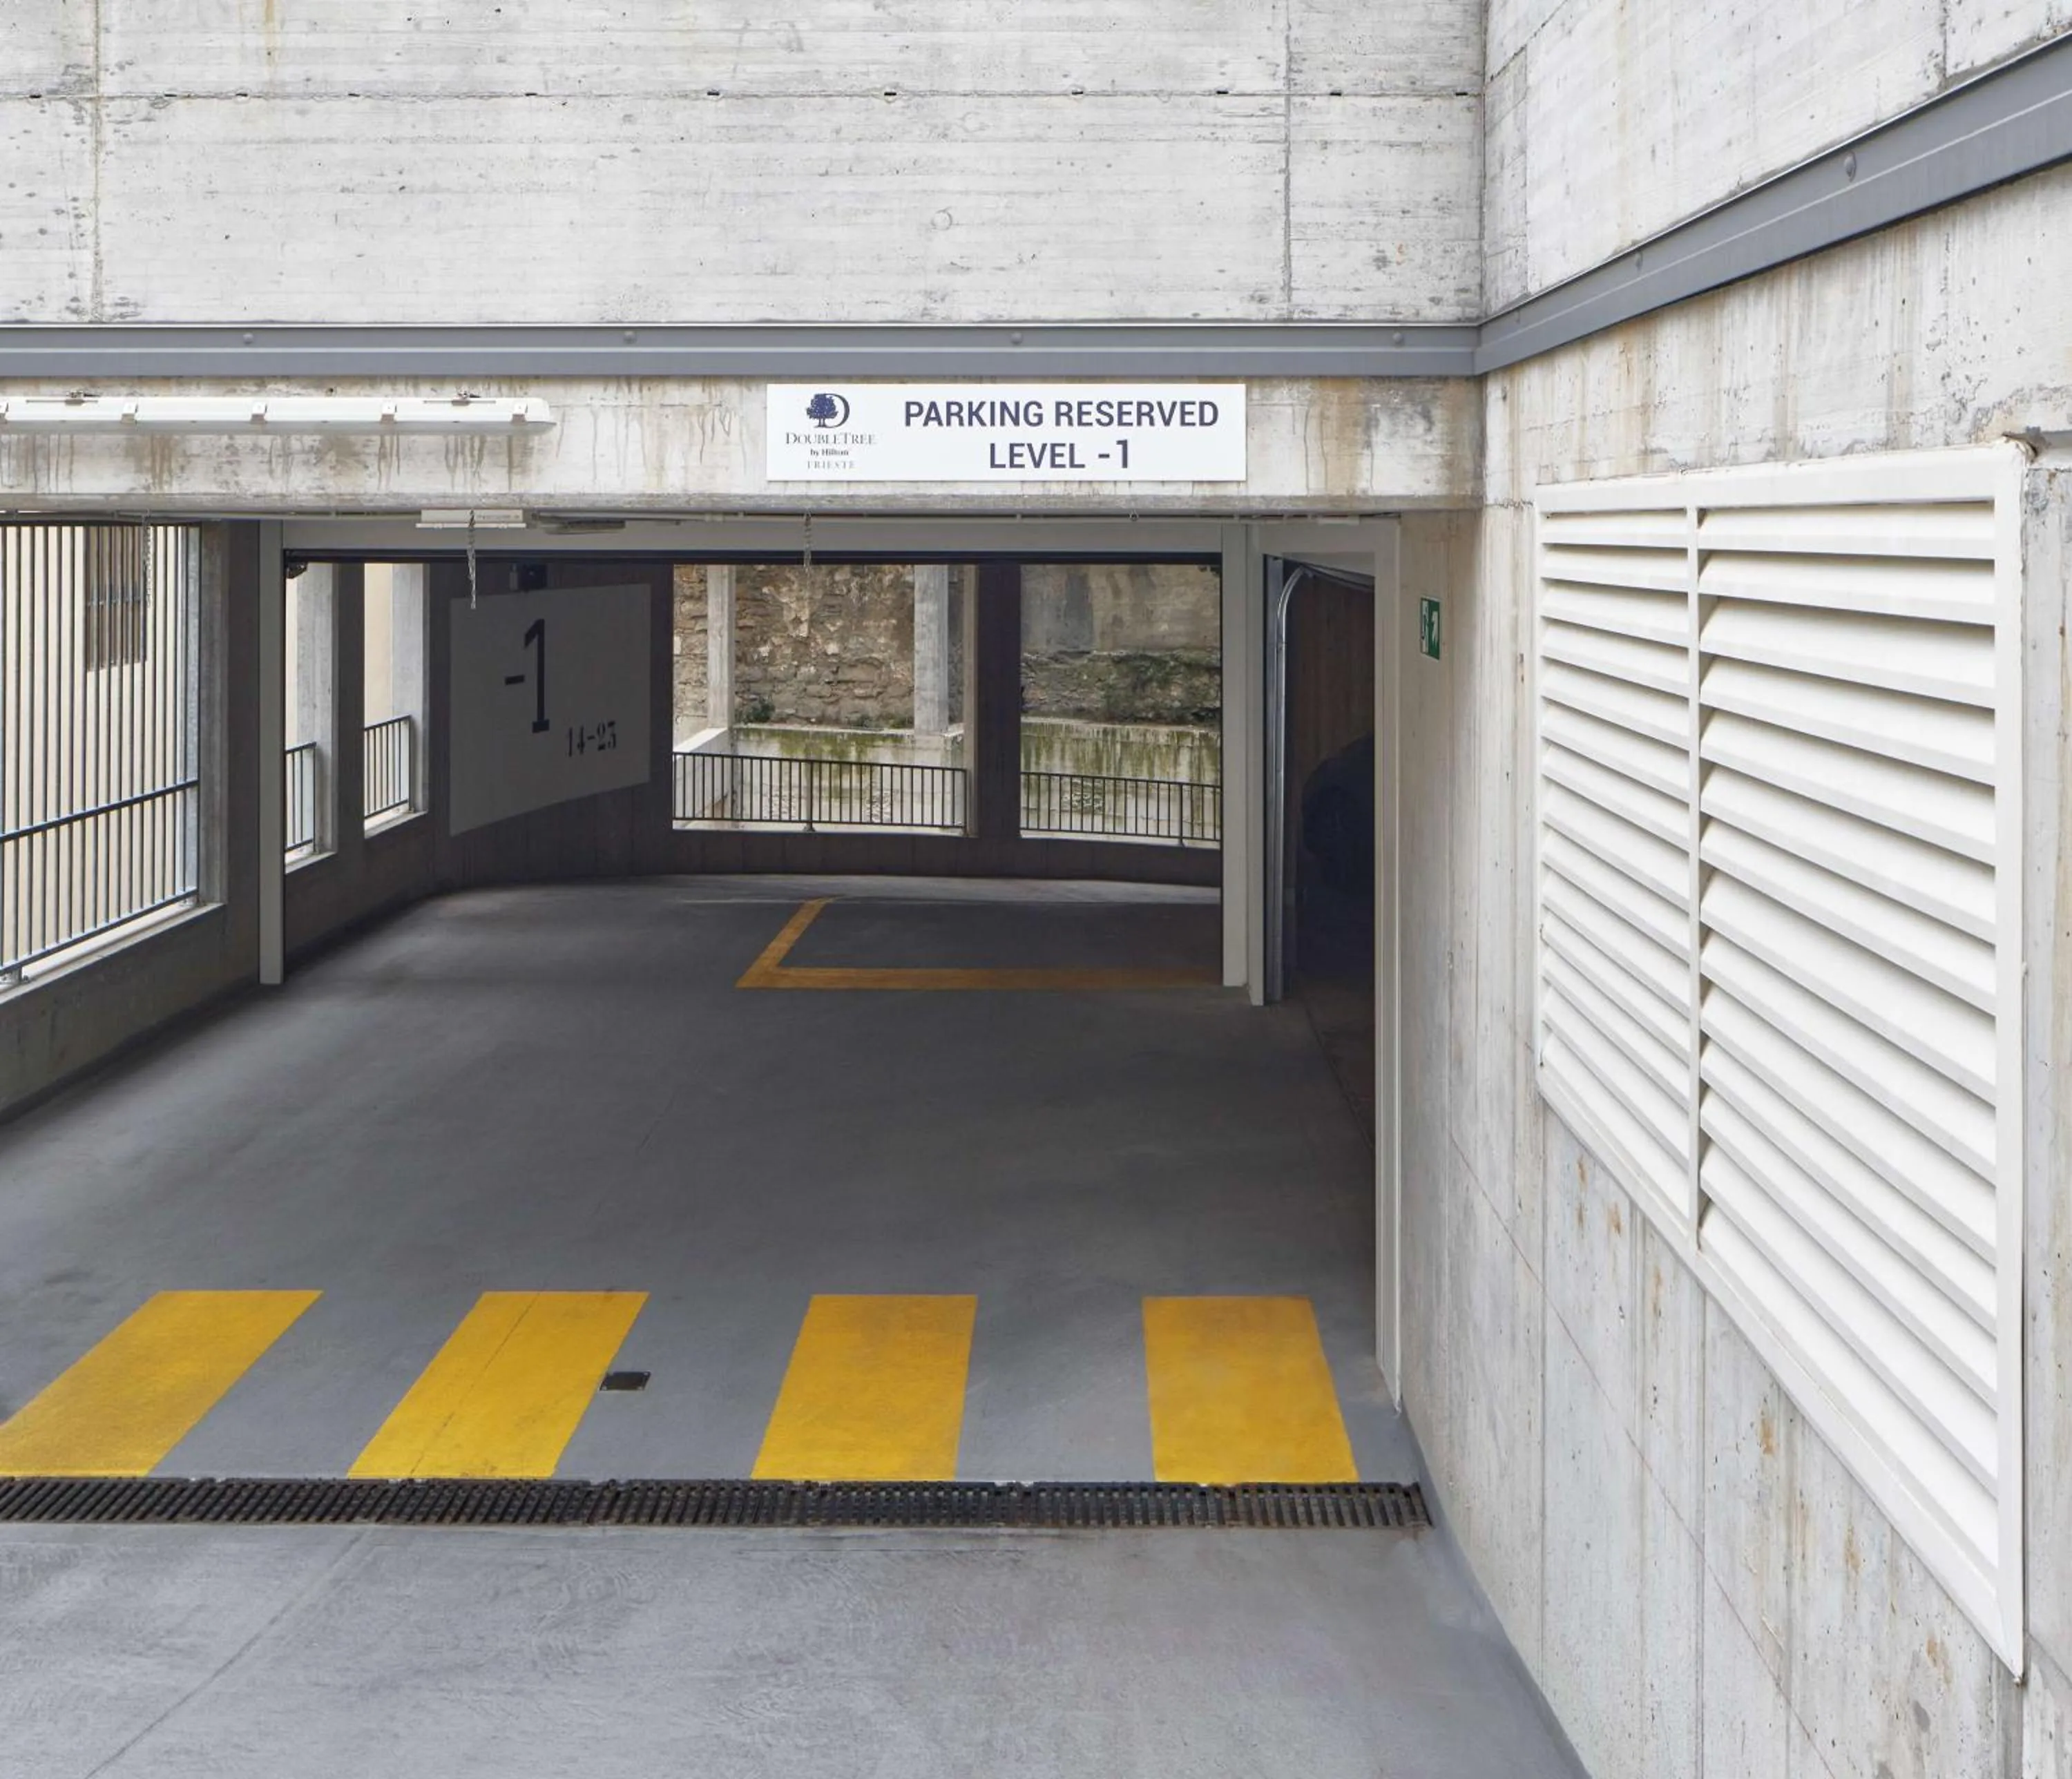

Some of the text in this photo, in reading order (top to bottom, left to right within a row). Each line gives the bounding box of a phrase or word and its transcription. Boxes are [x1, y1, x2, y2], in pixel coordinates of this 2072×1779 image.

[905, 401, 1218, 427] PARKING RESERVED
[810, 448, 849, 457] by Hilton
[990, 439, 1129, 469] LEVEL -1
[505, 619, 550, 733] -1
